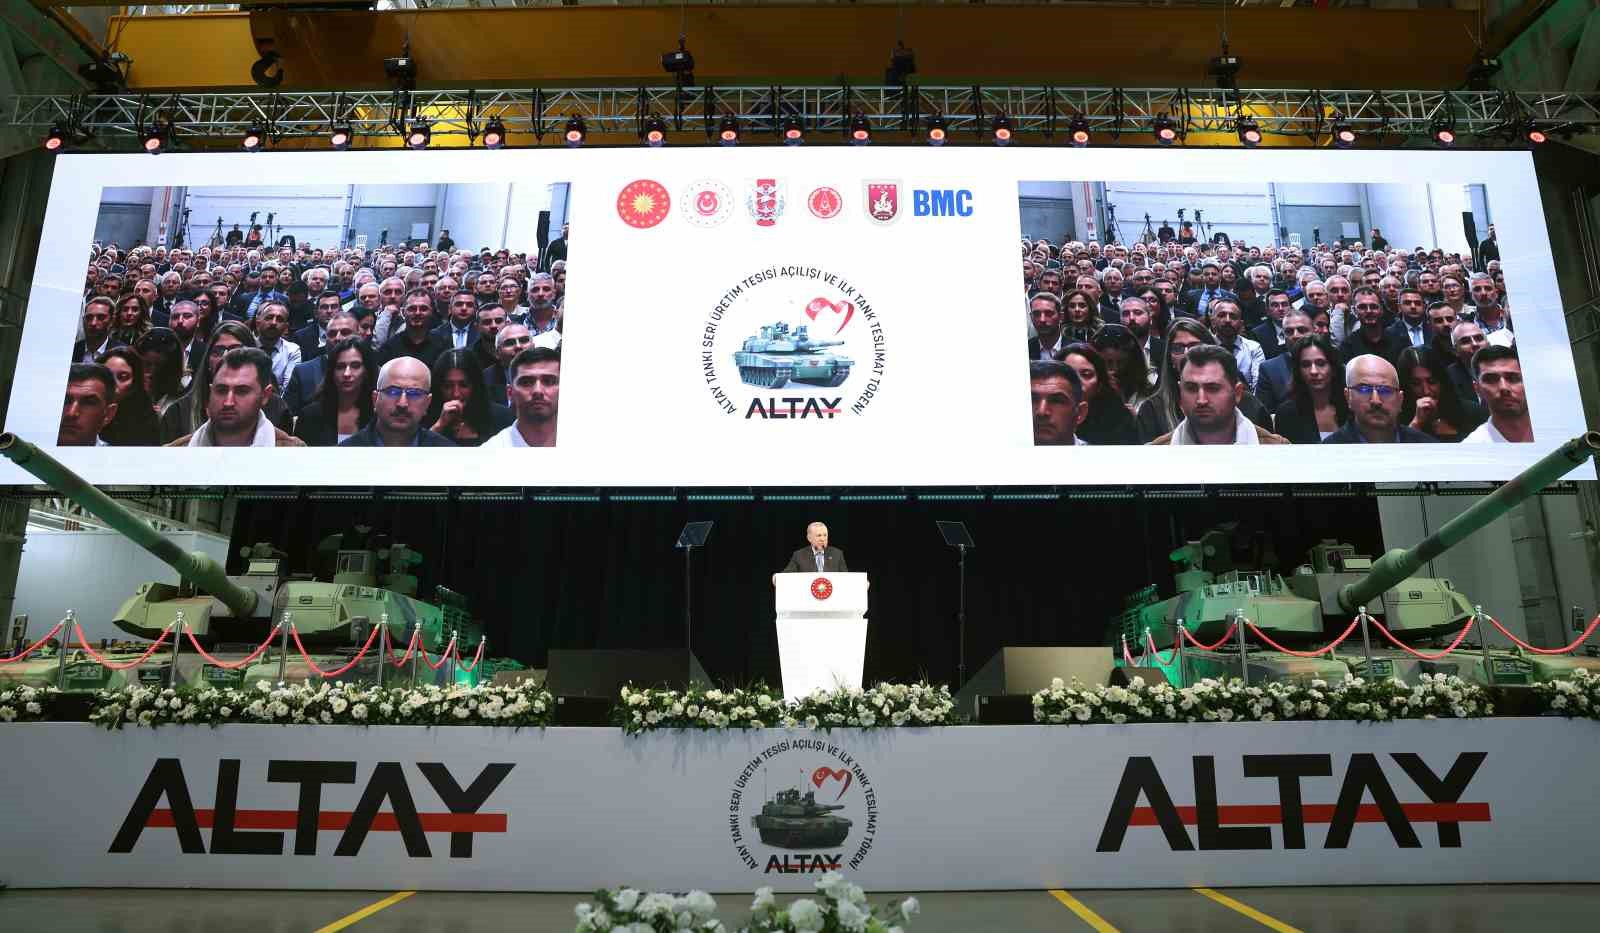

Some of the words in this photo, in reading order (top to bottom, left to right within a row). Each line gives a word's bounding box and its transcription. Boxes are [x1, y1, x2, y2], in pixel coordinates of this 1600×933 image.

[913, 189, 973, 217] BMC
[781, 265, 821, 280] AÇILIŞI
[823, 271, 839, 286] VE
[854, 293, 877, 321] TANK
[702, 351, 717, 385] TANKI
[710, 386, 737, 415] ALTAY
[745, 397, 842, 419] ALTAY
[792, 739, 826, 751] AÇILIŞI
[827, 743, 840, 757] VE
[852, 762, 870, 788] TANK
[108, 758, 517, 858] ALTAY
[1096, 752, 1490, 852] ALTAY
[729, 814, 743, 844] TANKI
[736, 844, 759, 870] ALTAY
[764, 854, 843, 873] ALTAY
